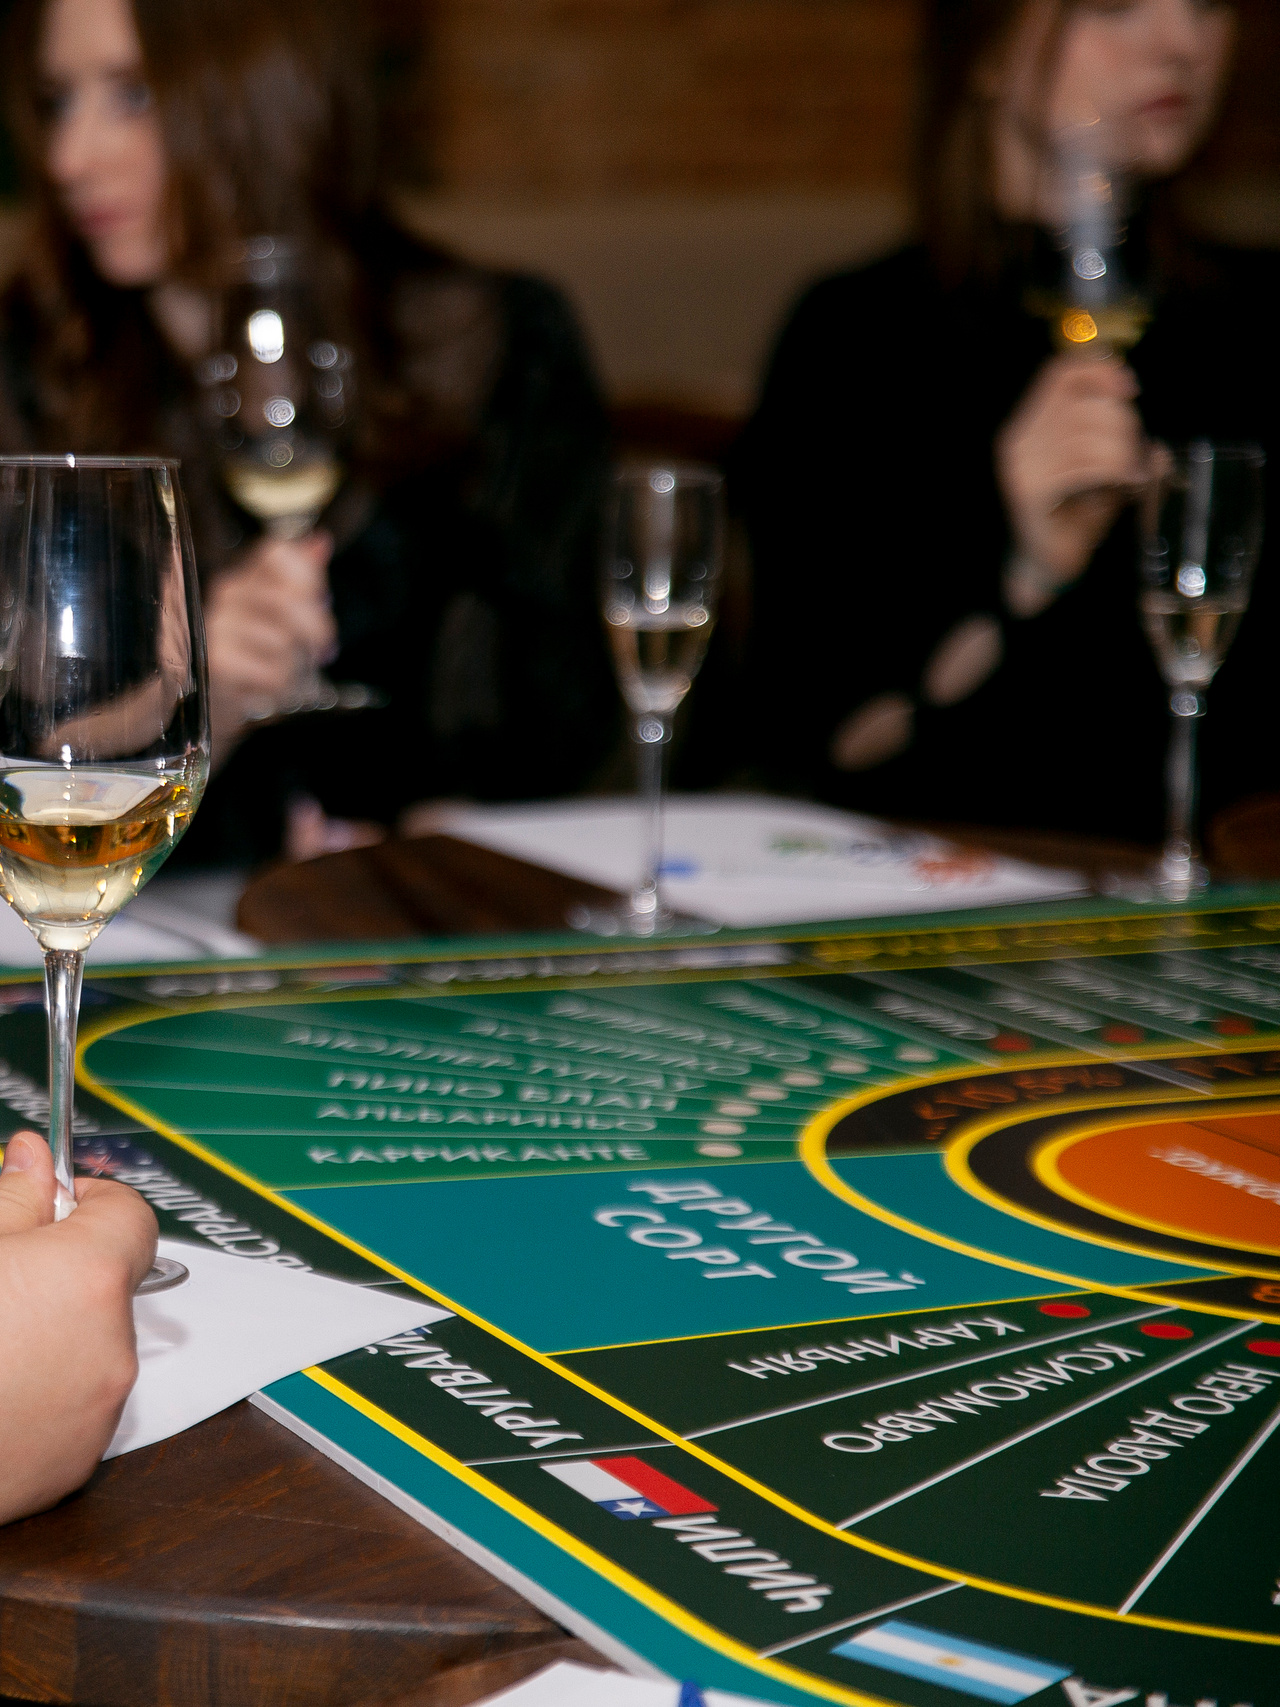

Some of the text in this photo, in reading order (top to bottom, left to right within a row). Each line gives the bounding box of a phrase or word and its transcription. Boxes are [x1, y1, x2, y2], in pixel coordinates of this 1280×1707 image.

[316, 1102, 657, 1132] АЛЬБАРИНЬО
[327, 1068, 678, 1113] ПИНО БЛАН
[307, 1142, 651, 1165] КАРРИКАНТЕ
[114, 1168, 314, 1273] ВСТРАЛИЯ
[592, 1205, 777, 1281] СОРТ
[629, 1179, 926, 1296] ДРУГОЙ
[728, 1316, 1025, 1380] КАРИНЬЯН
[823, 1341, 1146, 1455] КСИНОМАВРО
[1173, 1361, 1280, 1416] НЕРО
[653, 1513, 837, 1614] ЧИЛИ
